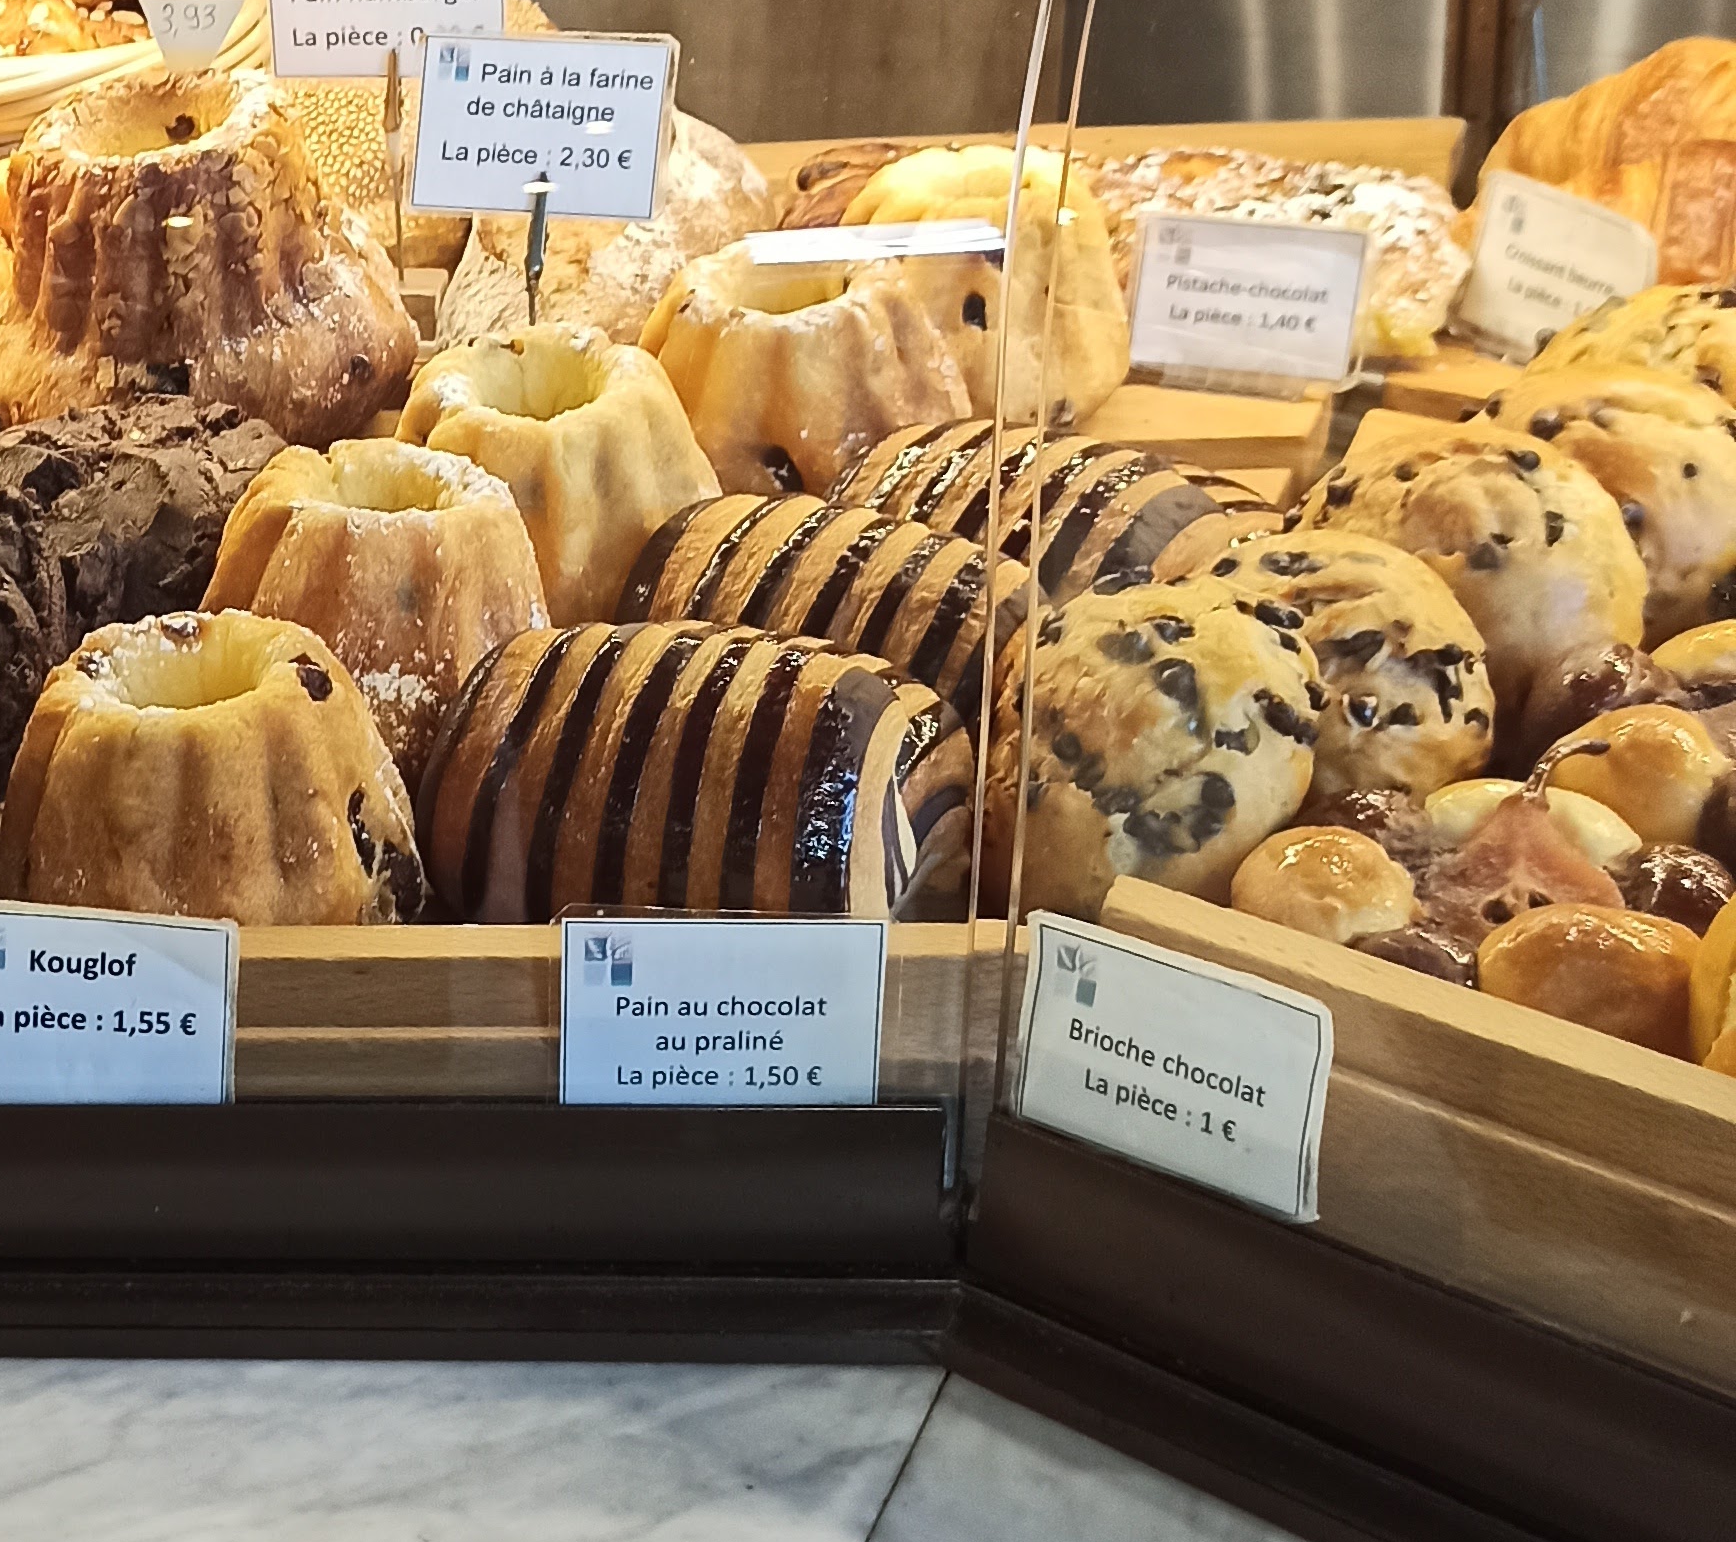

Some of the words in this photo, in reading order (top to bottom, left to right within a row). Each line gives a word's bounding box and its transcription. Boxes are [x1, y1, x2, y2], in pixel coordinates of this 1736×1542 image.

[160, 2, 217, 39] 3,93
[292, 27, 317, 46] La
[326, 26, 389, 50] pièce
[481, 62, 532, 85] Pain
[540, 66, 553, 86] à
[562, 66, 581, 87] la
[589, 67, 654, 91] farine
[466, 95, 495, 117] de
[503, 97, 615, 126] châtaigne
[441, 139, 469, 162] La
[476, 142, 538, 168] pièce
[559, 146, 610, 171] 2,30
[617, 149, 632, 169] €
[1166, 273, 1329, 304] Pistache-chocolat
[1169, 304, 1188, 321] La
[1193, 307, 1242, 327] pièce
[1258, 312, 1300, 332] 1,40
[1304, 315, 1317, 334] €
[29, 949, 137, 980] Kouglof
[14, 1004, 87, 1033] pièce
[113, 1009, 171, 1037] 1,55
[179, 1012, 197, 1036] €
[615, 995, 669, 1017] Pain
[677, 1000, 708, 1017] au
[716, 995, 828, 1017] chocolat
[655, 1033, 686, 1051] au
[694, 1029, 784, 1056] praliné
[616, 1065, 643, 1086] La
[652, 1065, 719, 1090] pièce
[744, 1065, 799, 1090] 1,50
[806, 1066, 823, 1087] €
[1068, 1017, 1156, 1067] Brioche
[1162, 1053, 1267, 1108] chocolat
[1084, 1067, 1109, 1096] La
[1115, 1081, 1178, 1121] pièce
[1200, 1111, 1213, 1134] 1
[1221, 1119, 1237, 1143] €
